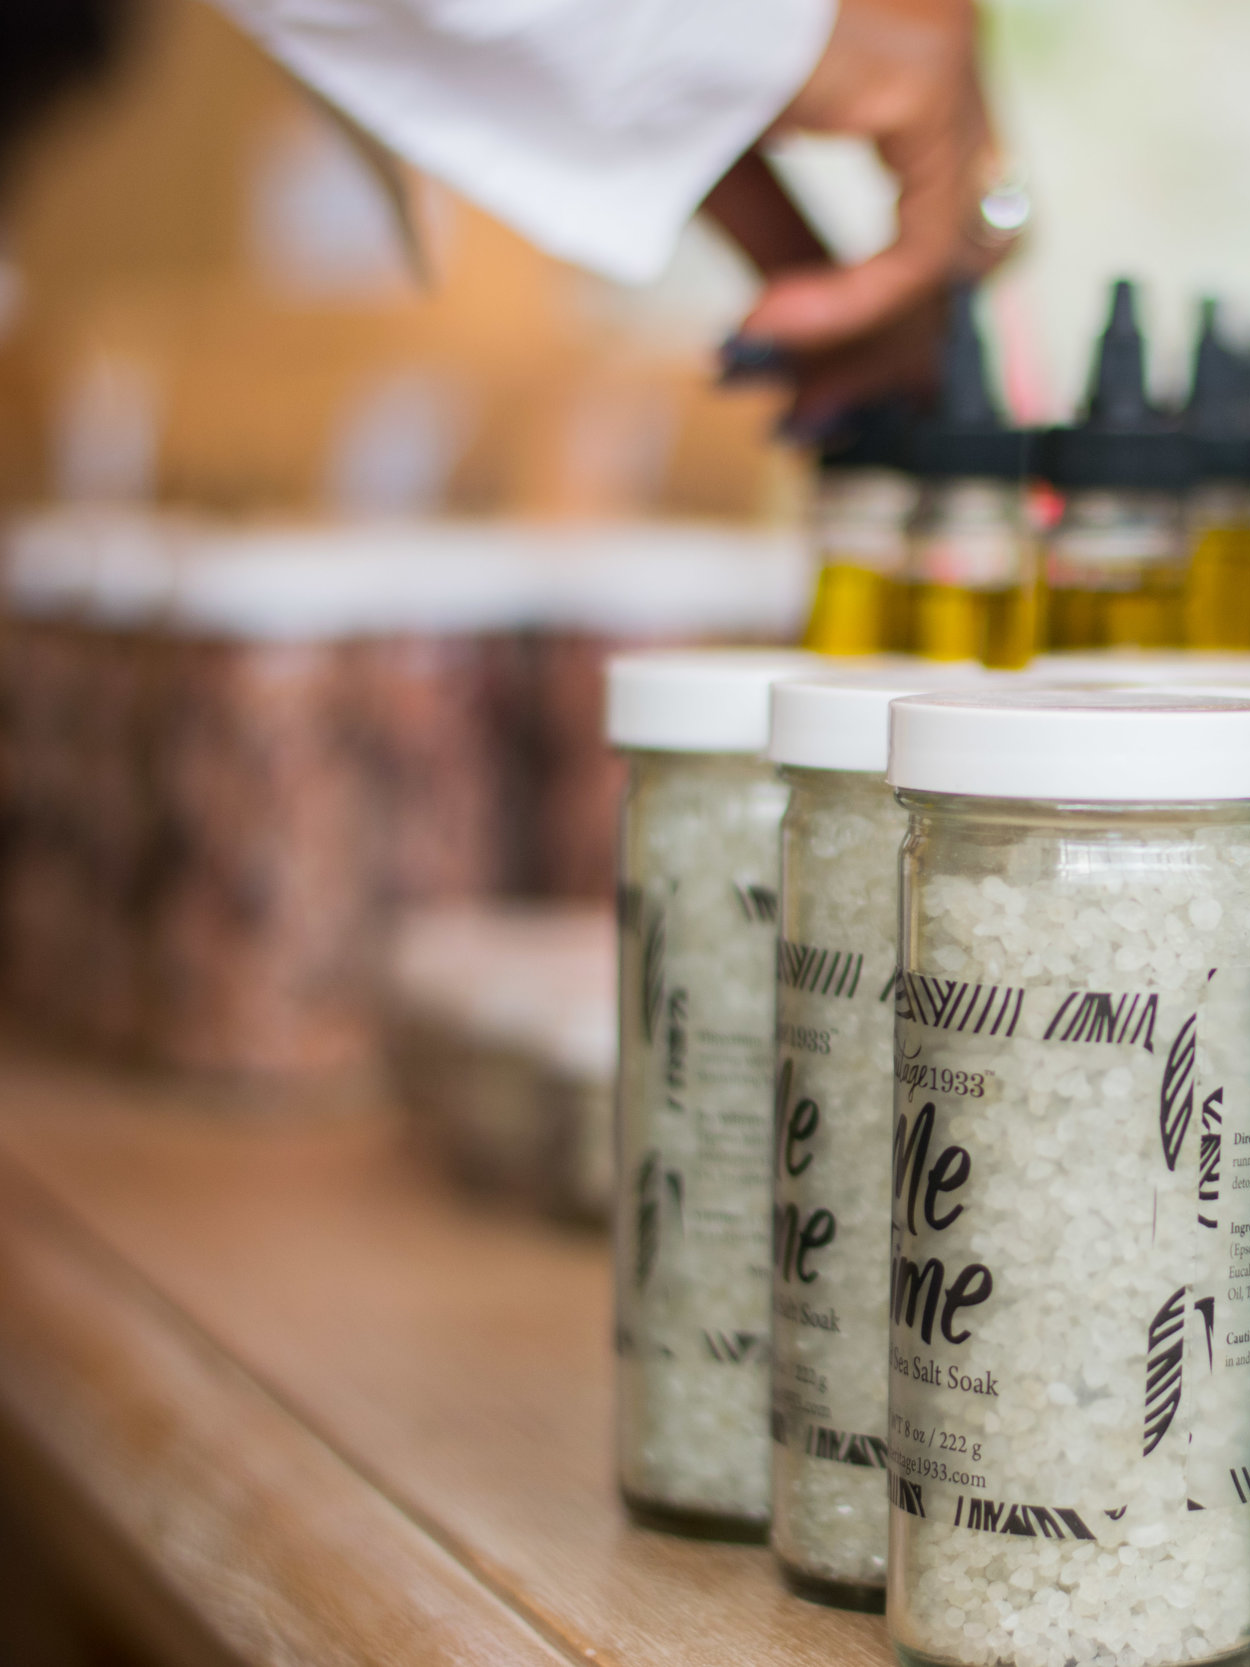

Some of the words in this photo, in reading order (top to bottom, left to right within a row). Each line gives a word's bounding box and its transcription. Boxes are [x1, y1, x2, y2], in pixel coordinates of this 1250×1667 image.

[1227, 1286, 1244, 1302] Oil,
[1224, 1355, 1234, 1368] in
[1235, 1351, 1250, 1366] and
[912, 1355, 942, 1386] Salt
[947, 1365, 1000, 1397] Soak
[904, 1420, 911, 1439] 8
[912, 1429, 926, 1444] oz
[939, 1431, 968, 1453] 222
[971, 1442, 982, 1462] g
